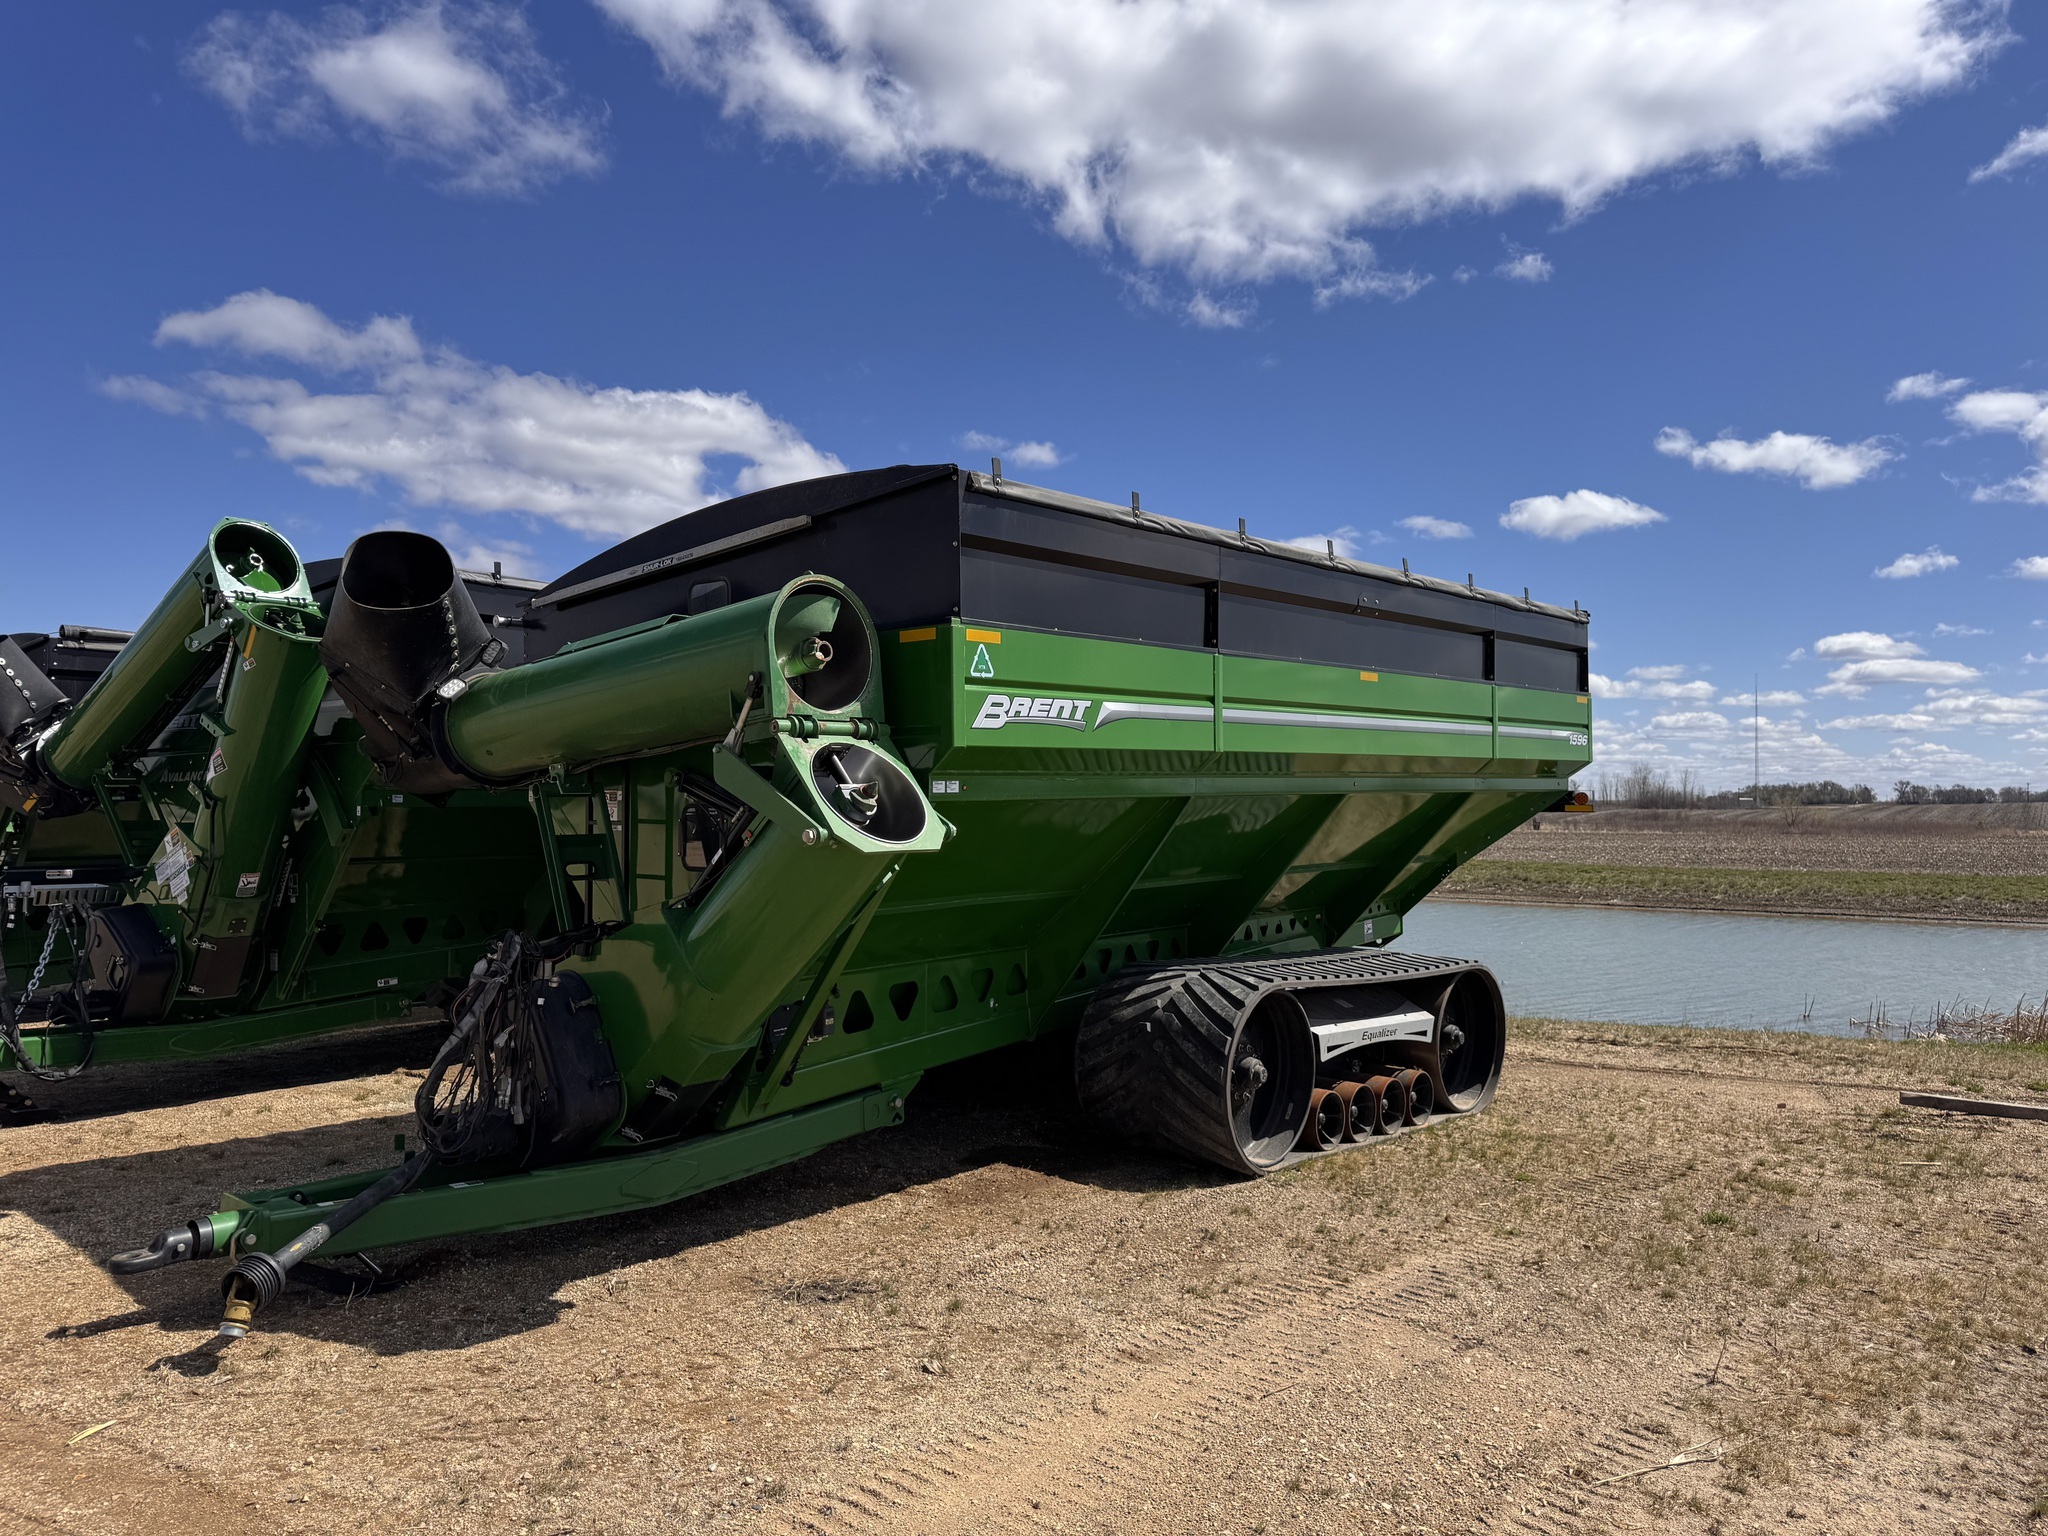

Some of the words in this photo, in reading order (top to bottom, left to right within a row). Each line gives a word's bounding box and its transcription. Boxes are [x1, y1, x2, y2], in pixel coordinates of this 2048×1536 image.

[971, 694, 1092, 729] BRENT
[1569, 734, 1588, 746] 1596
[1361, 1028, 1398, 1042] Equalizer
